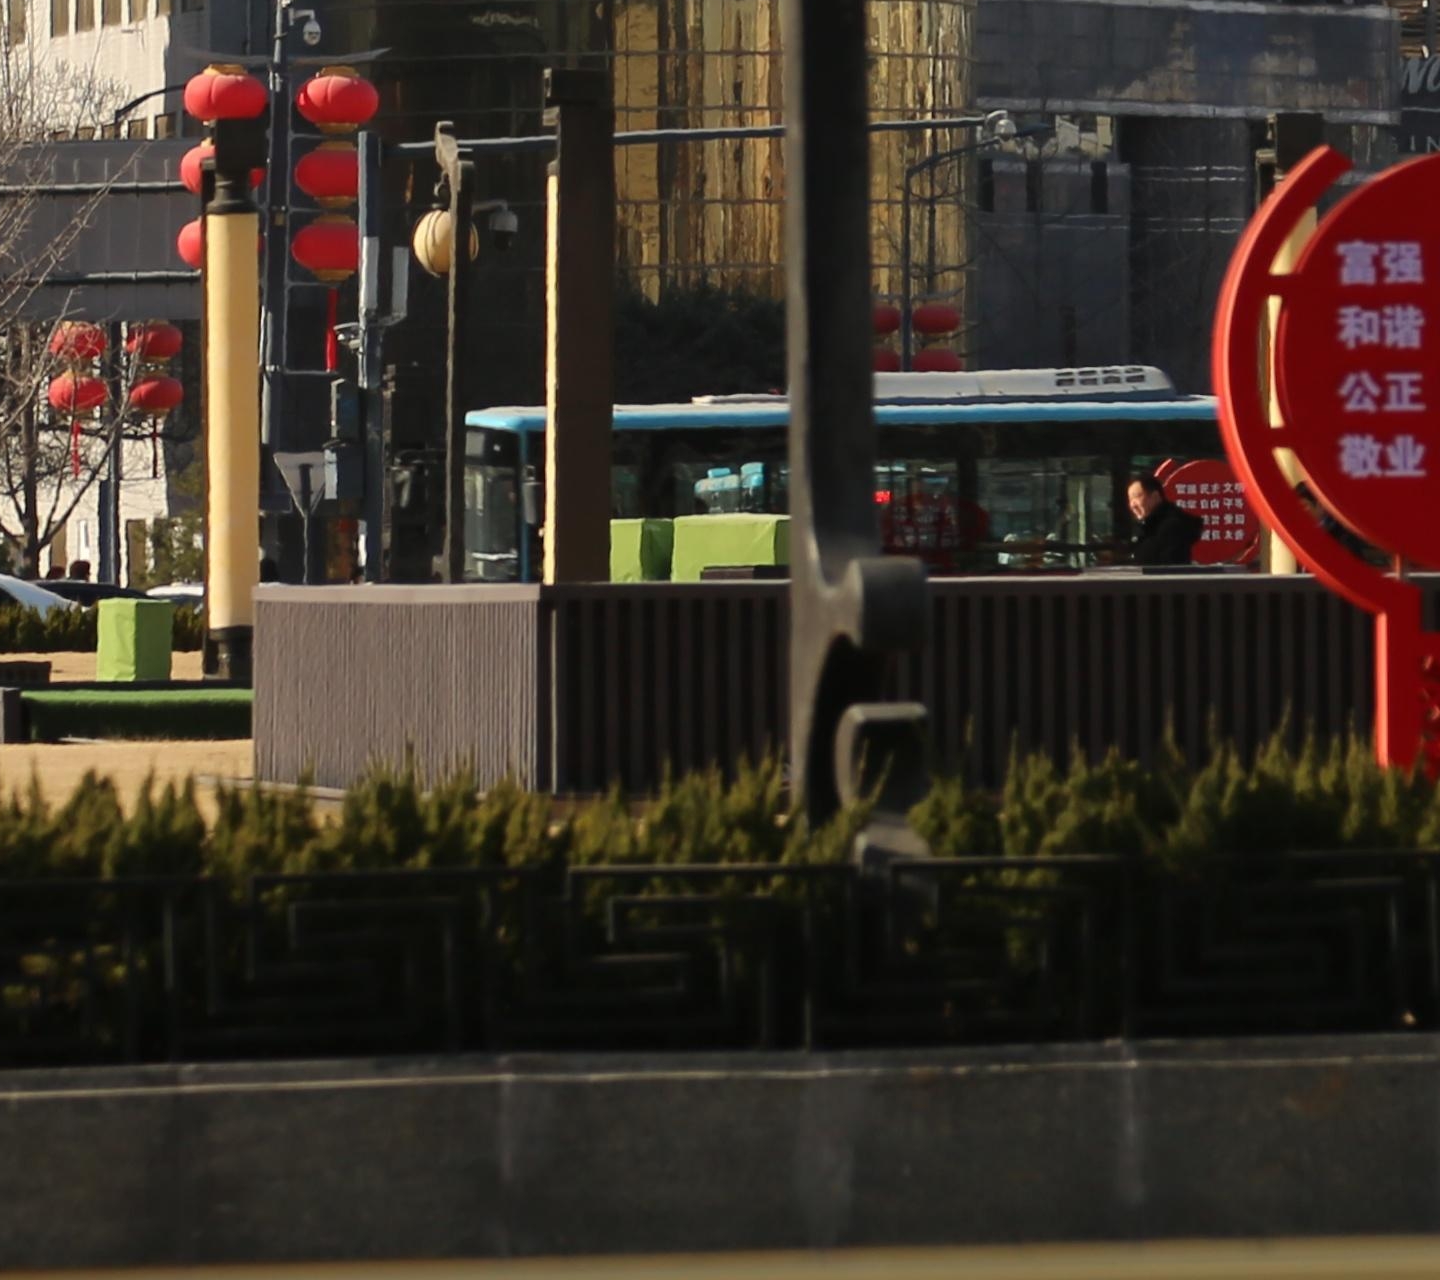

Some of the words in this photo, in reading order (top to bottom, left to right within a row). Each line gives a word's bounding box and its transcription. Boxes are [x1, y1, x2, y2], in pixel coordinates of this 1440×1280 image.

[1337, 241, 1424, 285] 富强
[1338, 305, 1425, 349] 和谐
[1339, 371, 1426, 412] 公正
[1339, 434, 1426, 477] 敬业
